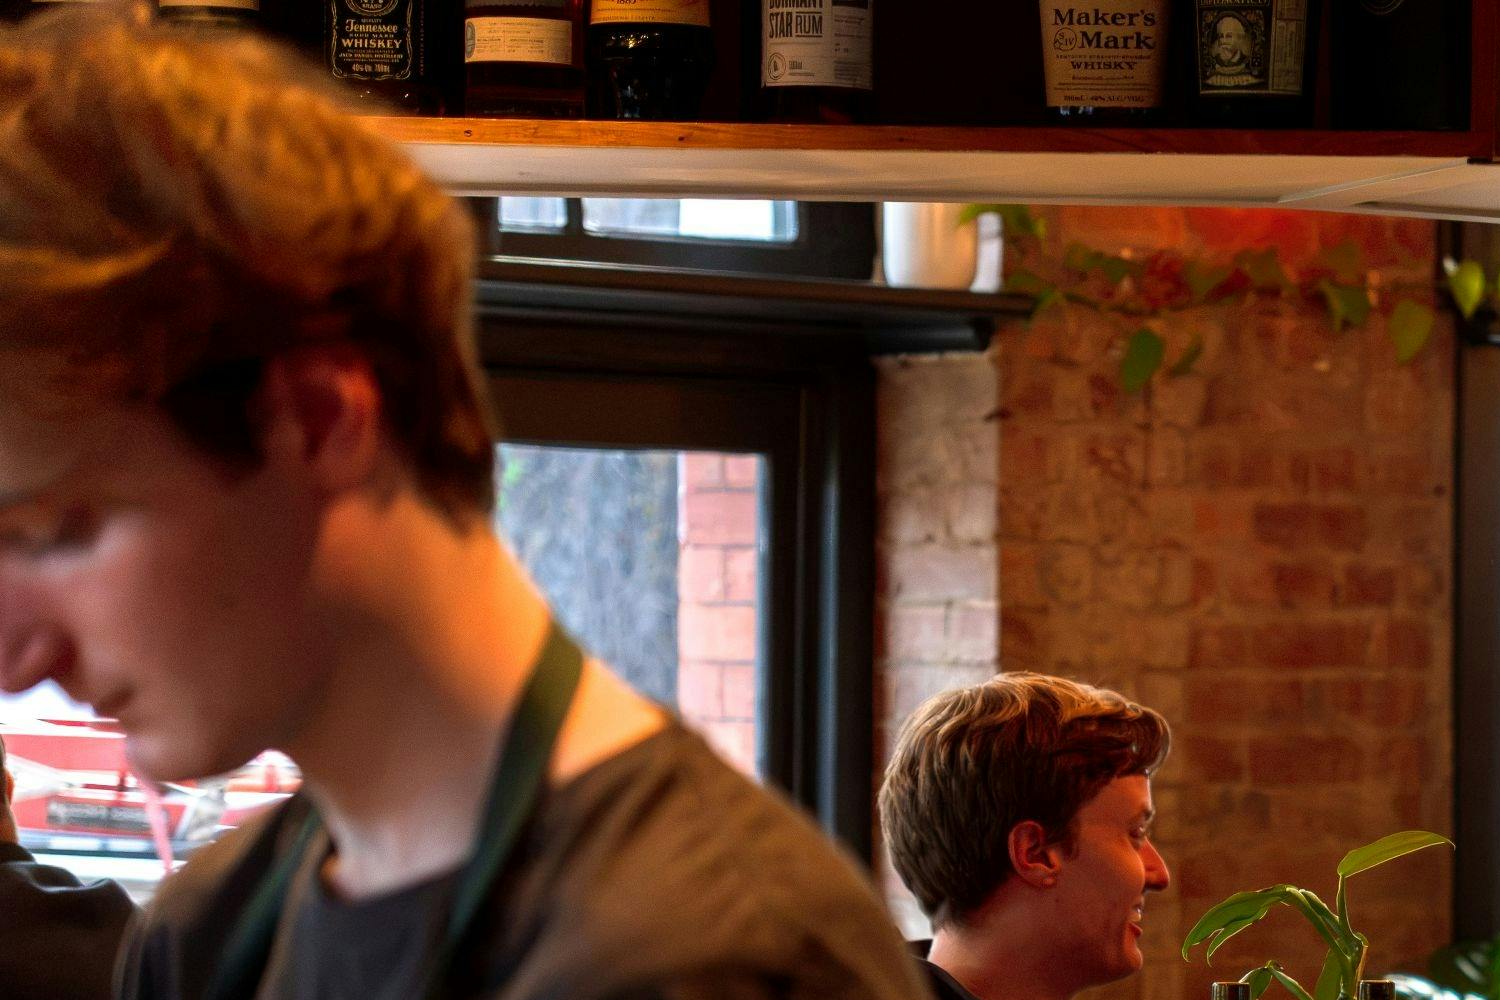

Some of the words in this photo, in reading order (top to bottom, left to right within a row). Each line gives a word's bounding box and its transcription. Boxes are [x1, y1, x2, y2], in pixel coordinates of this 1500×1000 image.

[768, 12, 793, 38] STAR
[795, 15, 823, 35] RUM
[1052, 8, 1157, 27] Maker's
[345, 19, 398, 33] Tennessee
[341, 38, 402, 49] WHISKEY
[1078, 31, 1156, 49] Mark
[1071, 61, 1138, 71] WHISKY
